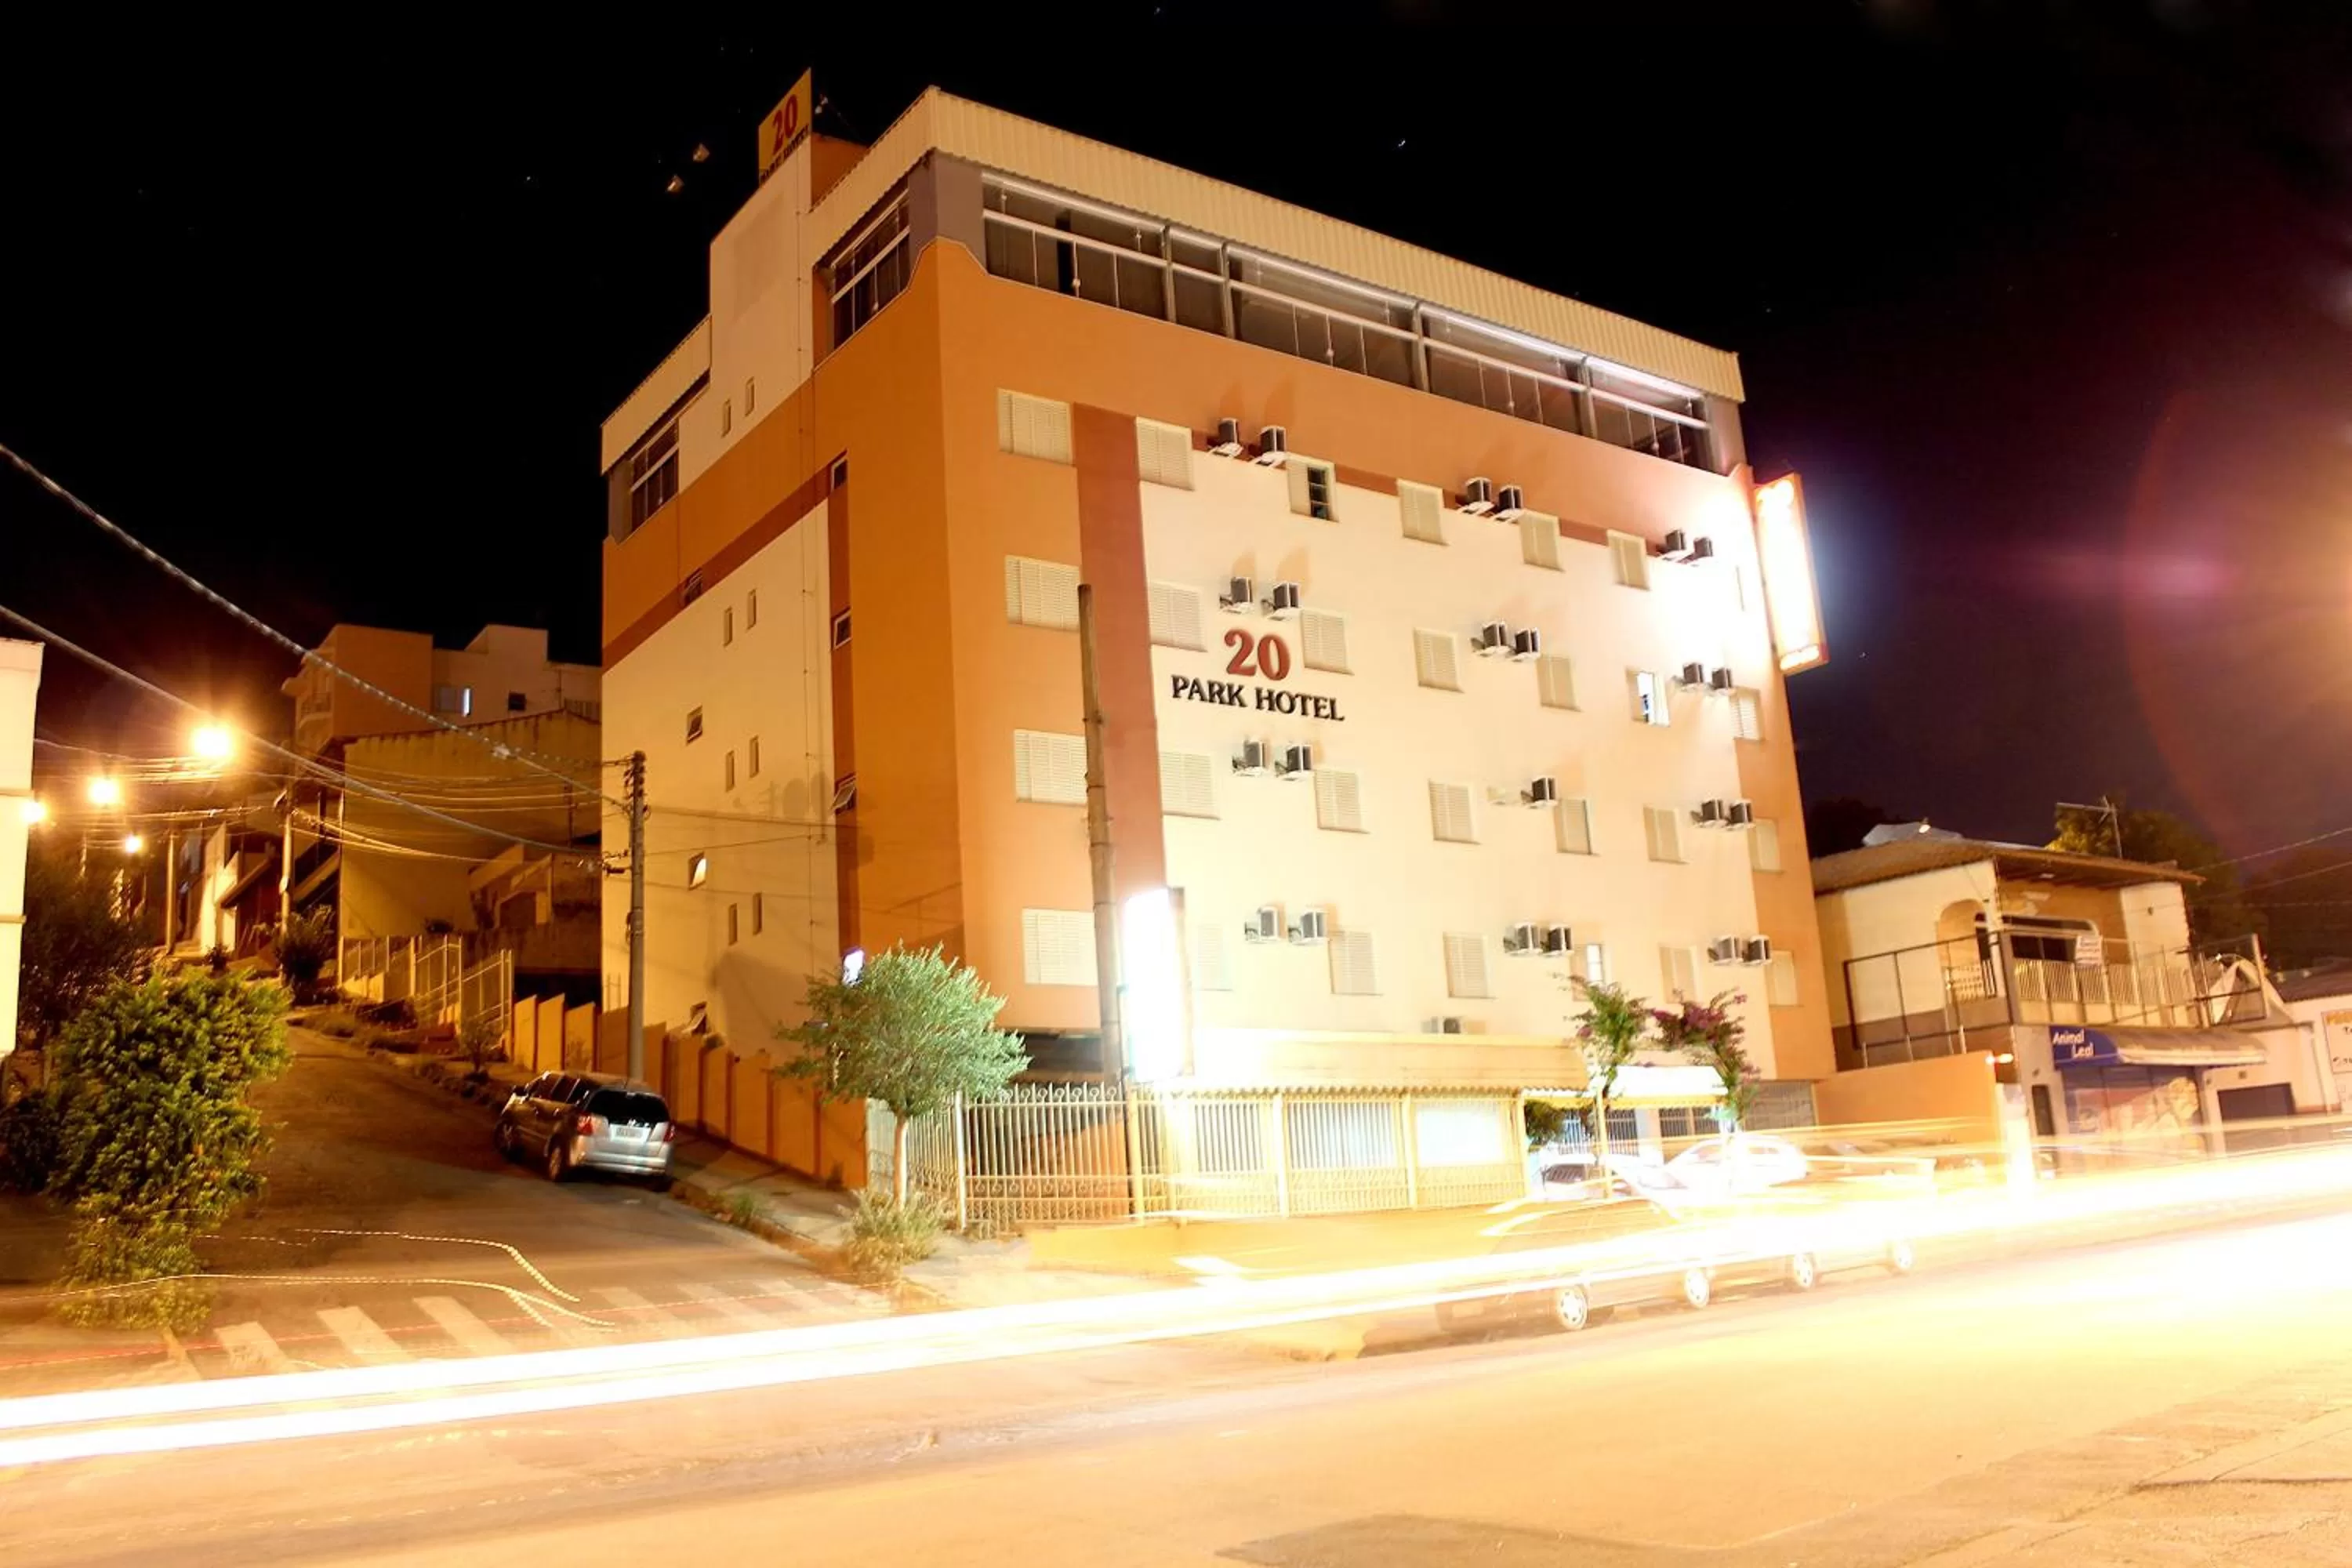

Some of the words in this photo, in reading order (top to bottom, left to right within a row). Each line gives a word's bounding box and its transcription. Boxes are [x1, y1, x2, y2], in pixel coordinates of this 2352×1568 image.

[772, 94, 798, 155] 20
[1225, 629, 1290, 681] 20
[1171, 674, 1247, 708] PARK
[1254, 686, 1345, 721] HOTEL
[2053, 1029, 2084, 1044] Animal
[2071, 1042, 2094, 1058] Leal
